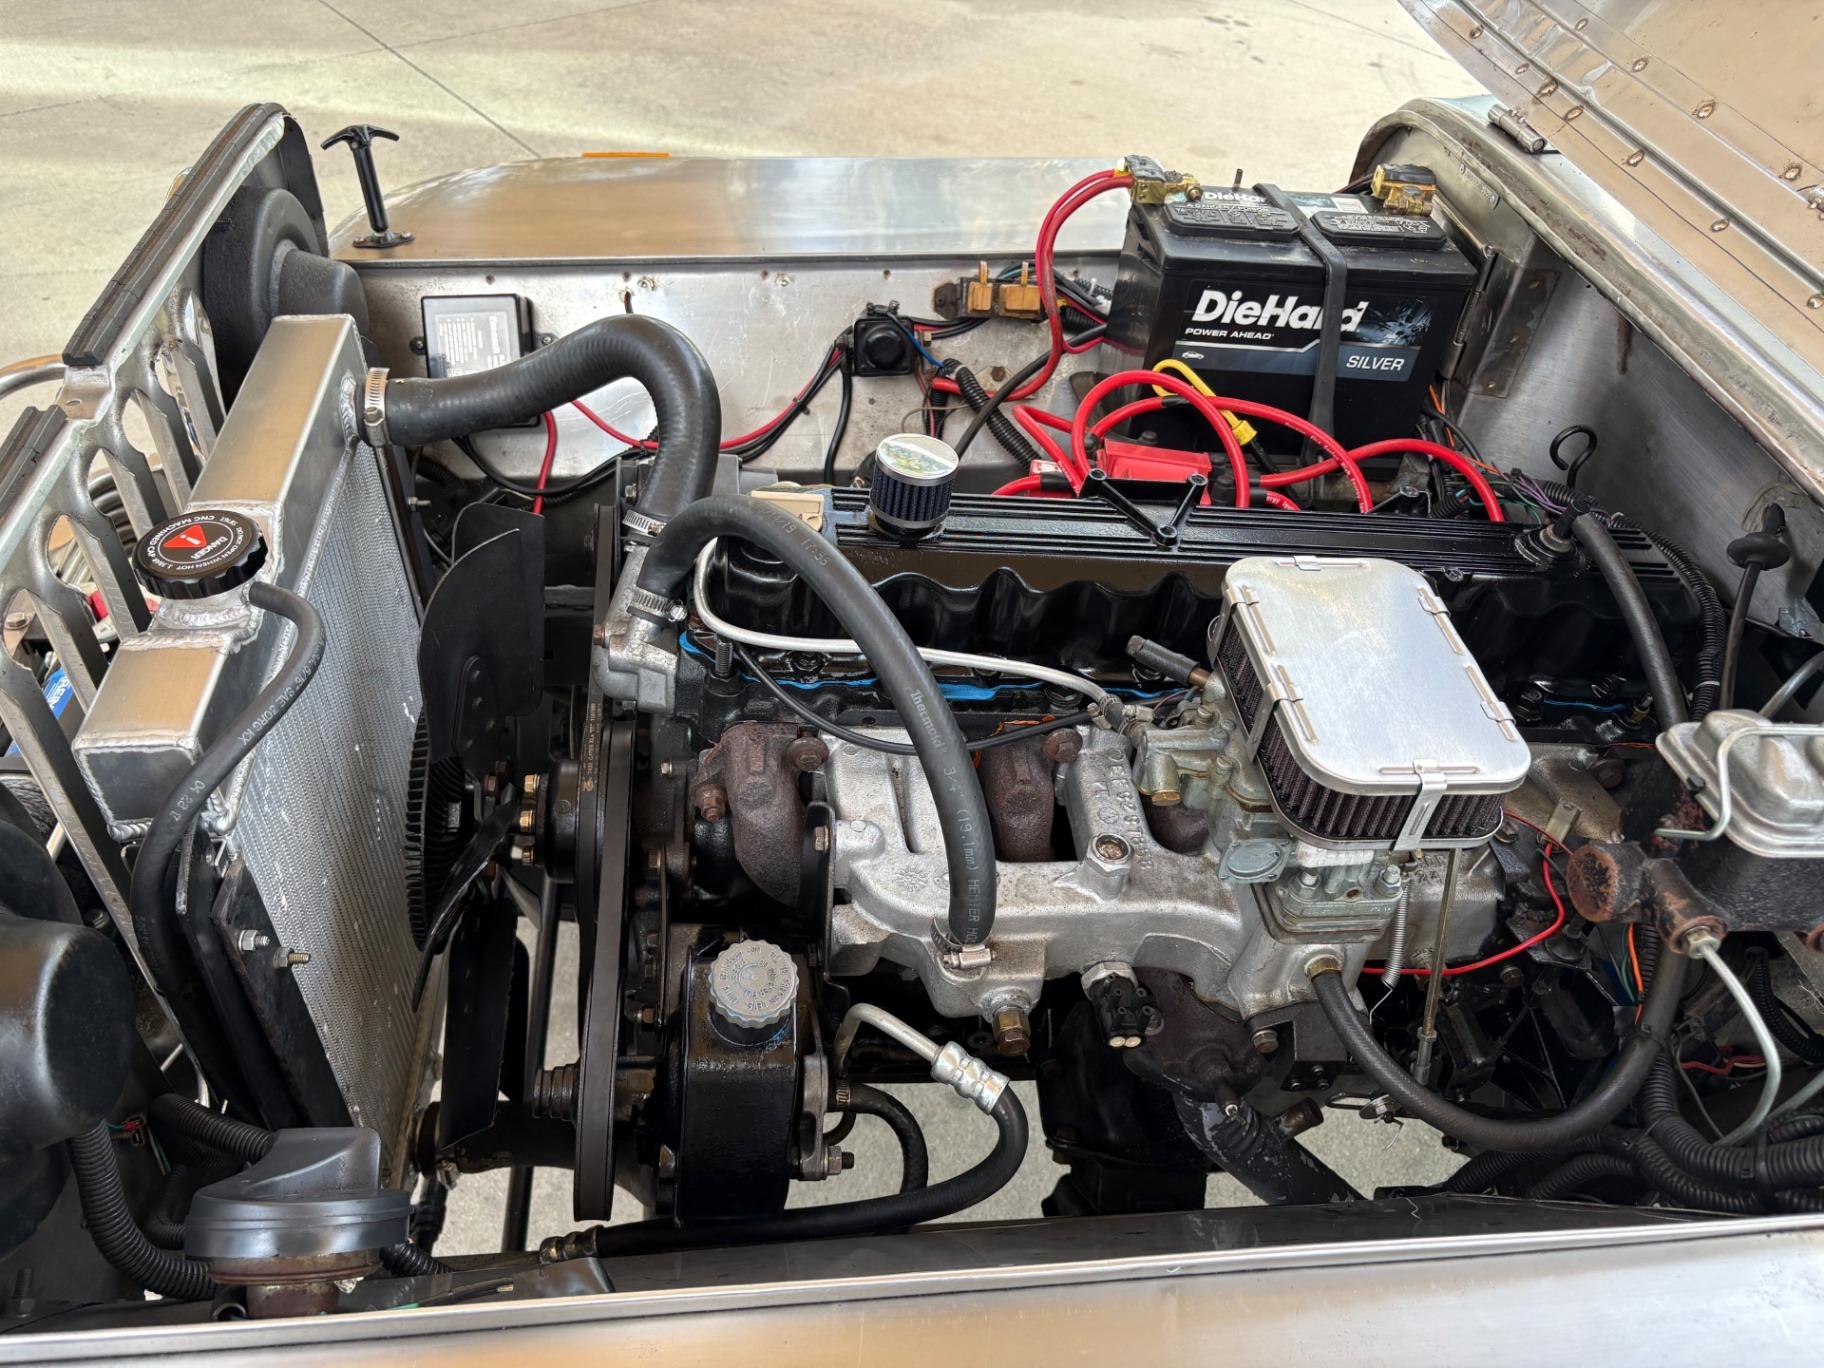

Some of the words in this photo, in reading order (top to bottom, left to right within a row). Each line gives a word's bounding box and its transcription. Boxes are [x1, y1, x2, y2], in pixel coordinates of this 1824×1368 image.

[1185, 327, 1228, 338] POWER
[1230, 330, 1272, 340] AHEAD
[1346, 354, 1405, 372] SILVER
[191, 536, 228, 560] DANGER
